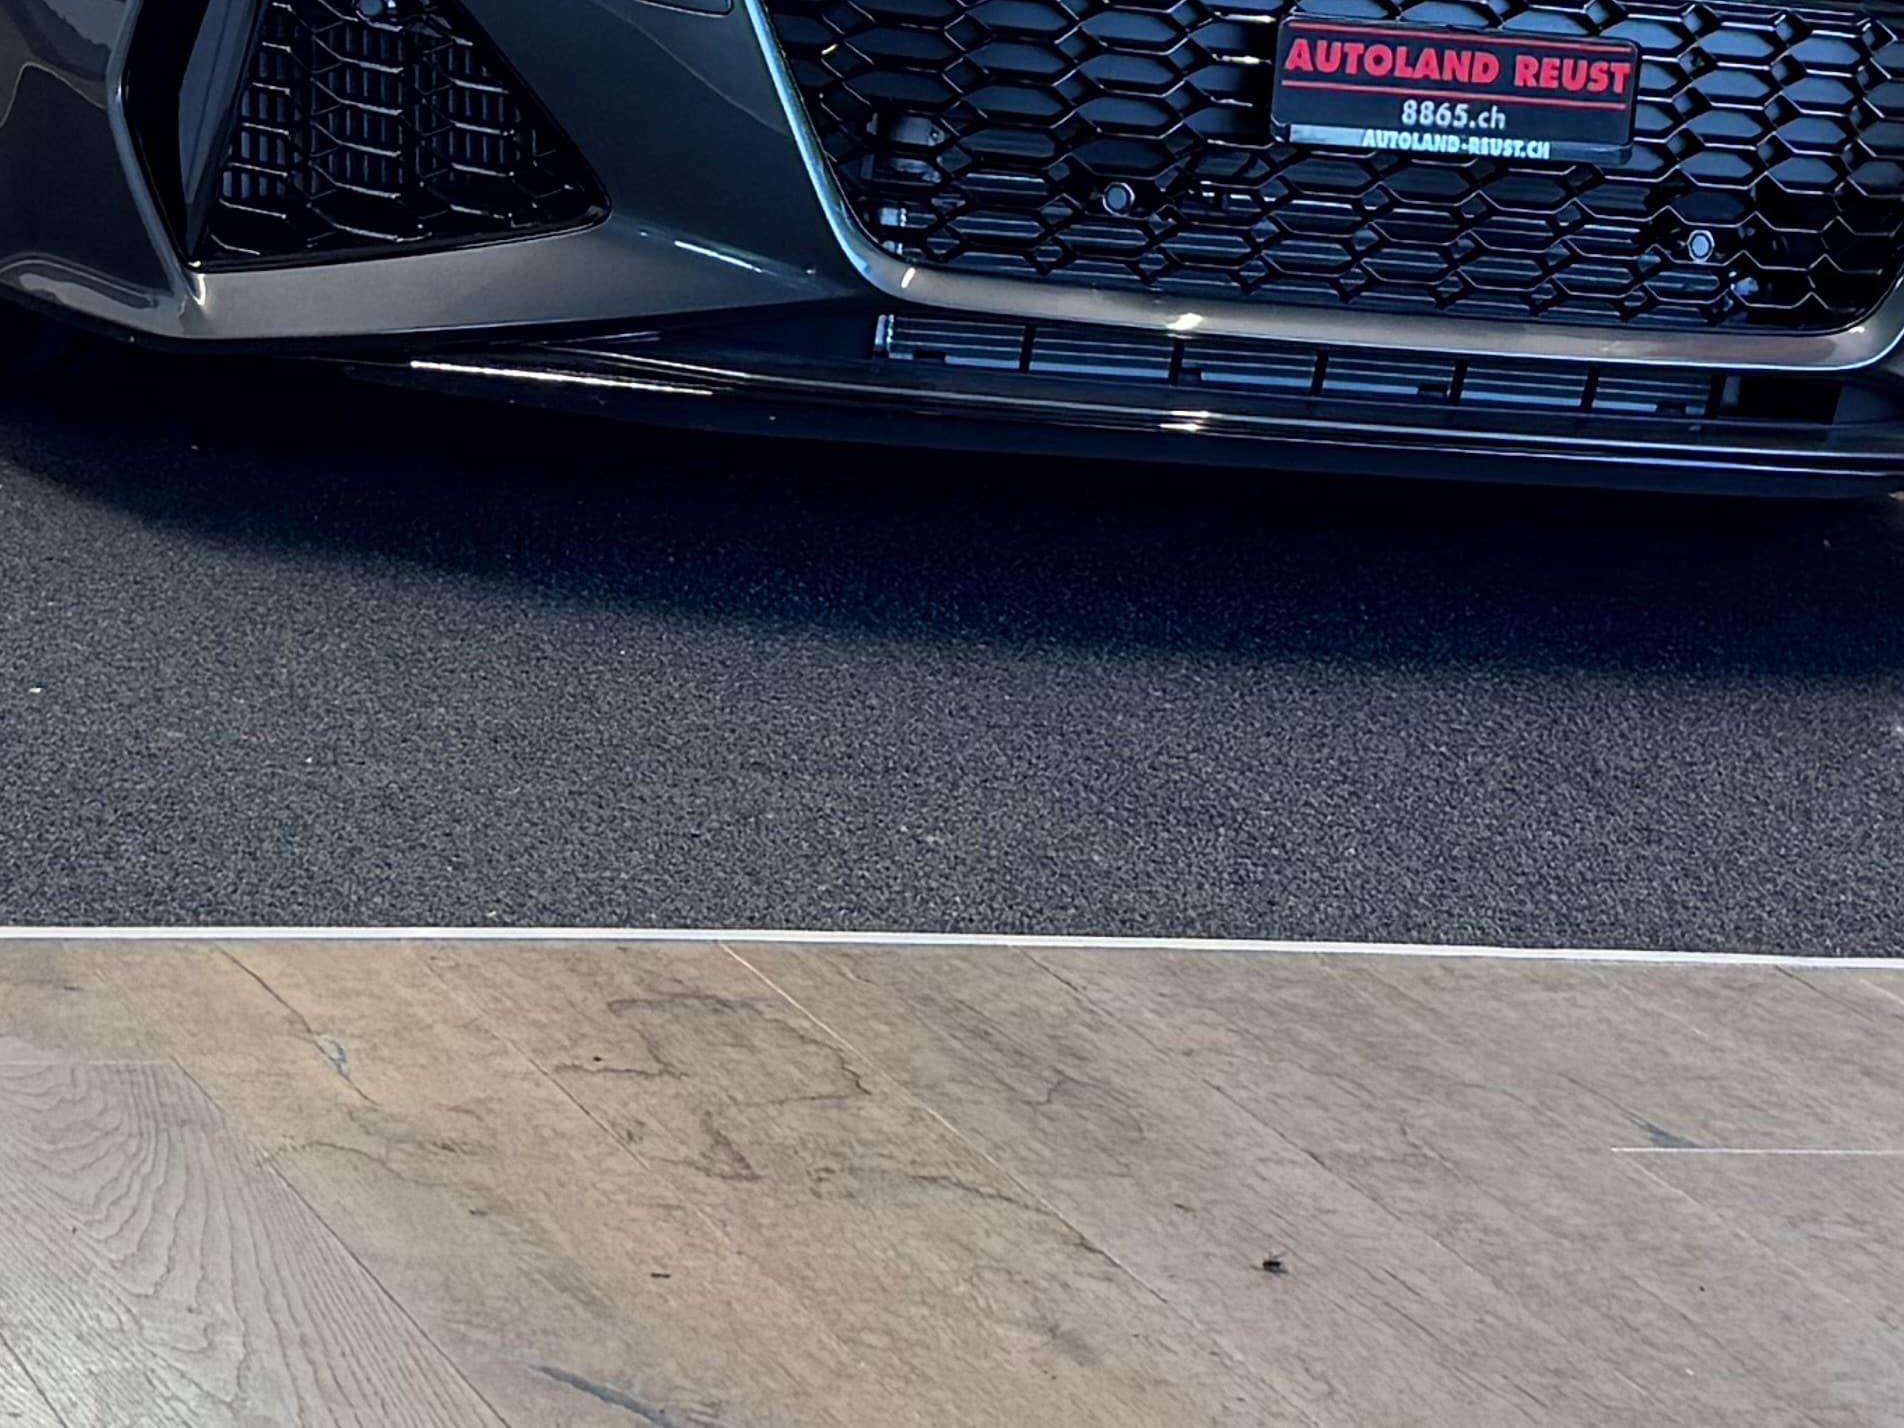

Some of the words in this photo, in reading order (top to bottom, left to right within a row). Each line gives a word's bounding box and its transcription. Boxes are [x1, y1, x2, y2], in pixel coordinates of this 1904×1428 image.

[1284, 38, 1499, 85] AUTOLAND
[1513, 54, 1631, 94] REUST
[1401, 98, 1507, 130] 8865.ch
